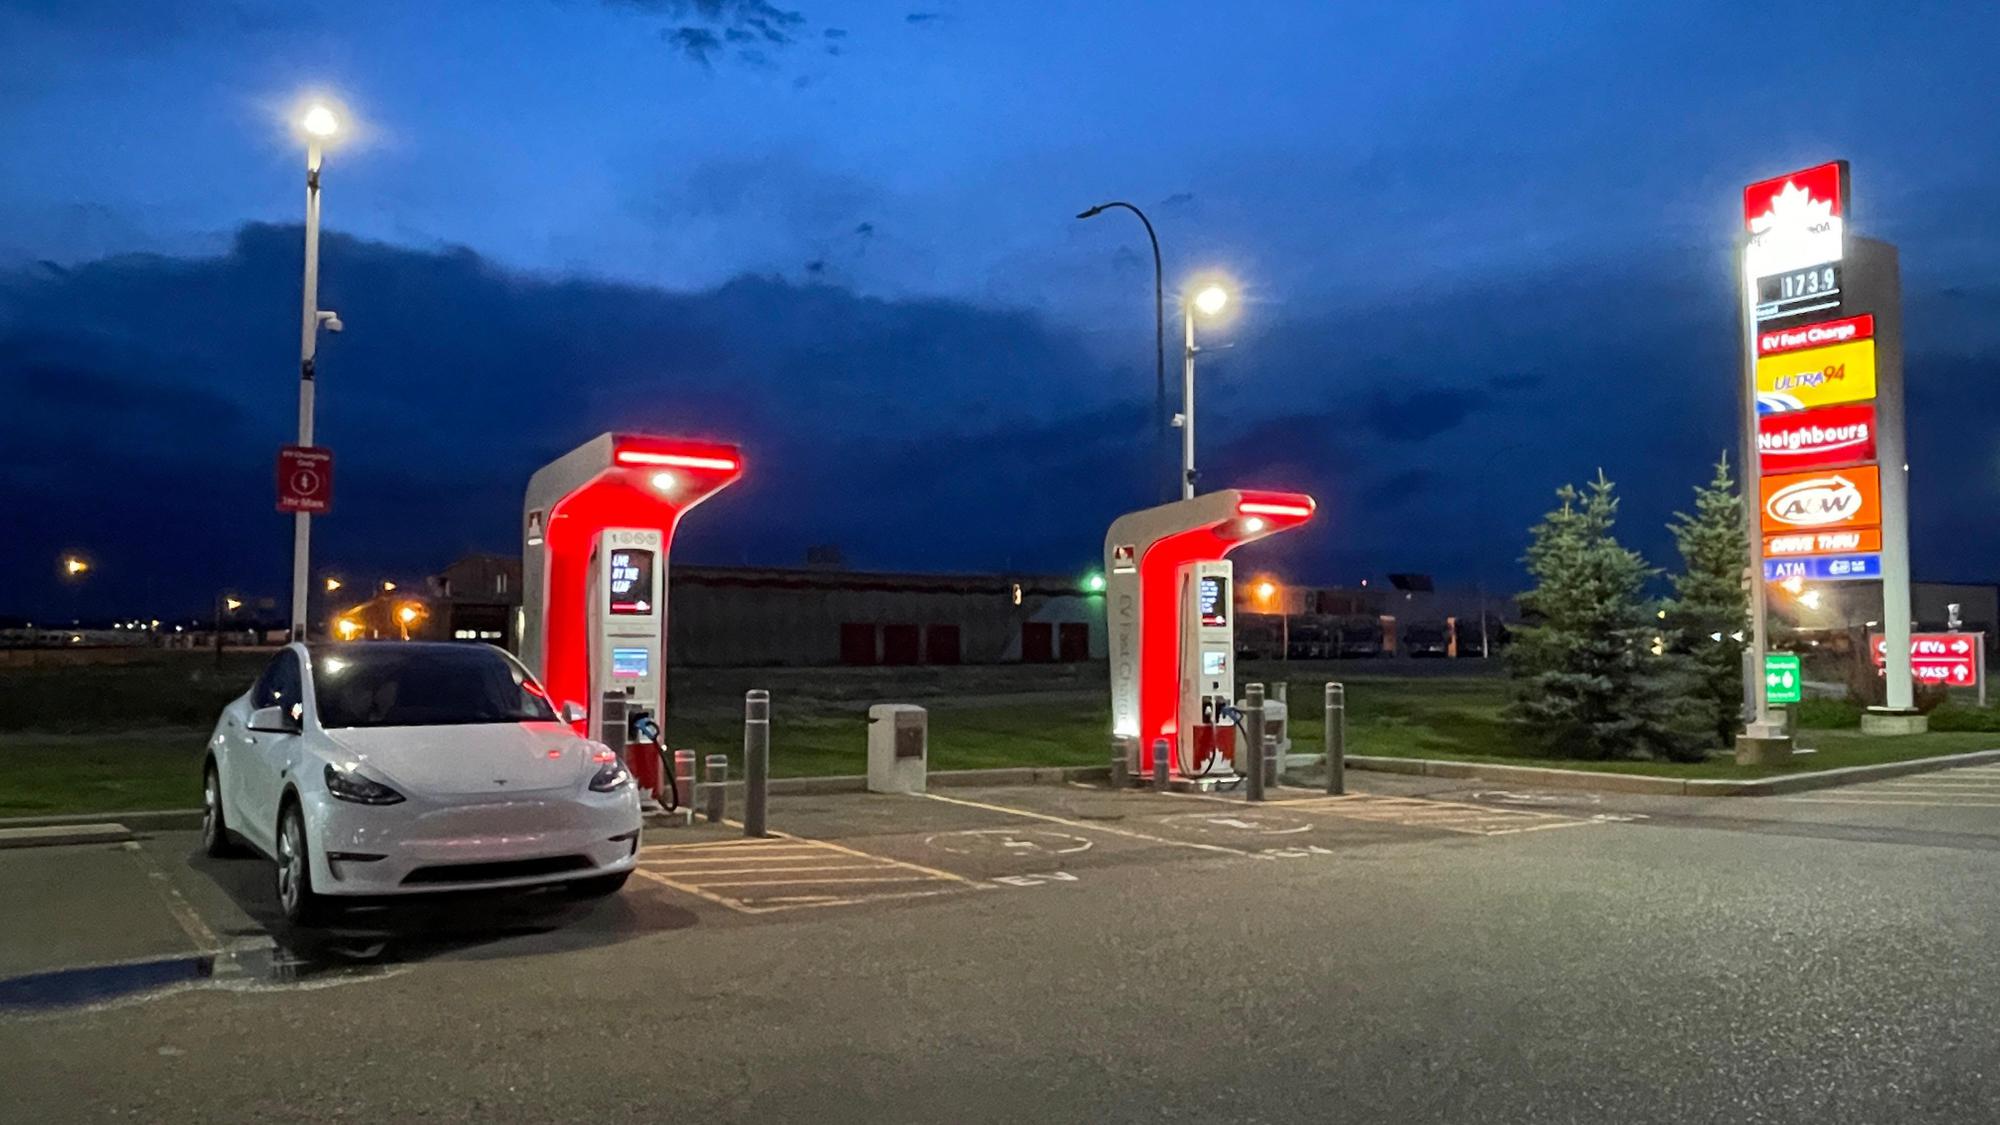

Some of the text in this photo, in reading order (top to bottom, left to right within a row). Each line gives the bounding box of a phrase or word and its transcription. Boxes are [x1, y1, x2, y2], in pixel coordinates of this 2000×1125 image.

[1807, 324, 1857, 341] Charge
[1758, 423, 1868, 450] Neighbours
[1775, 562, 1806, 577] ATM
